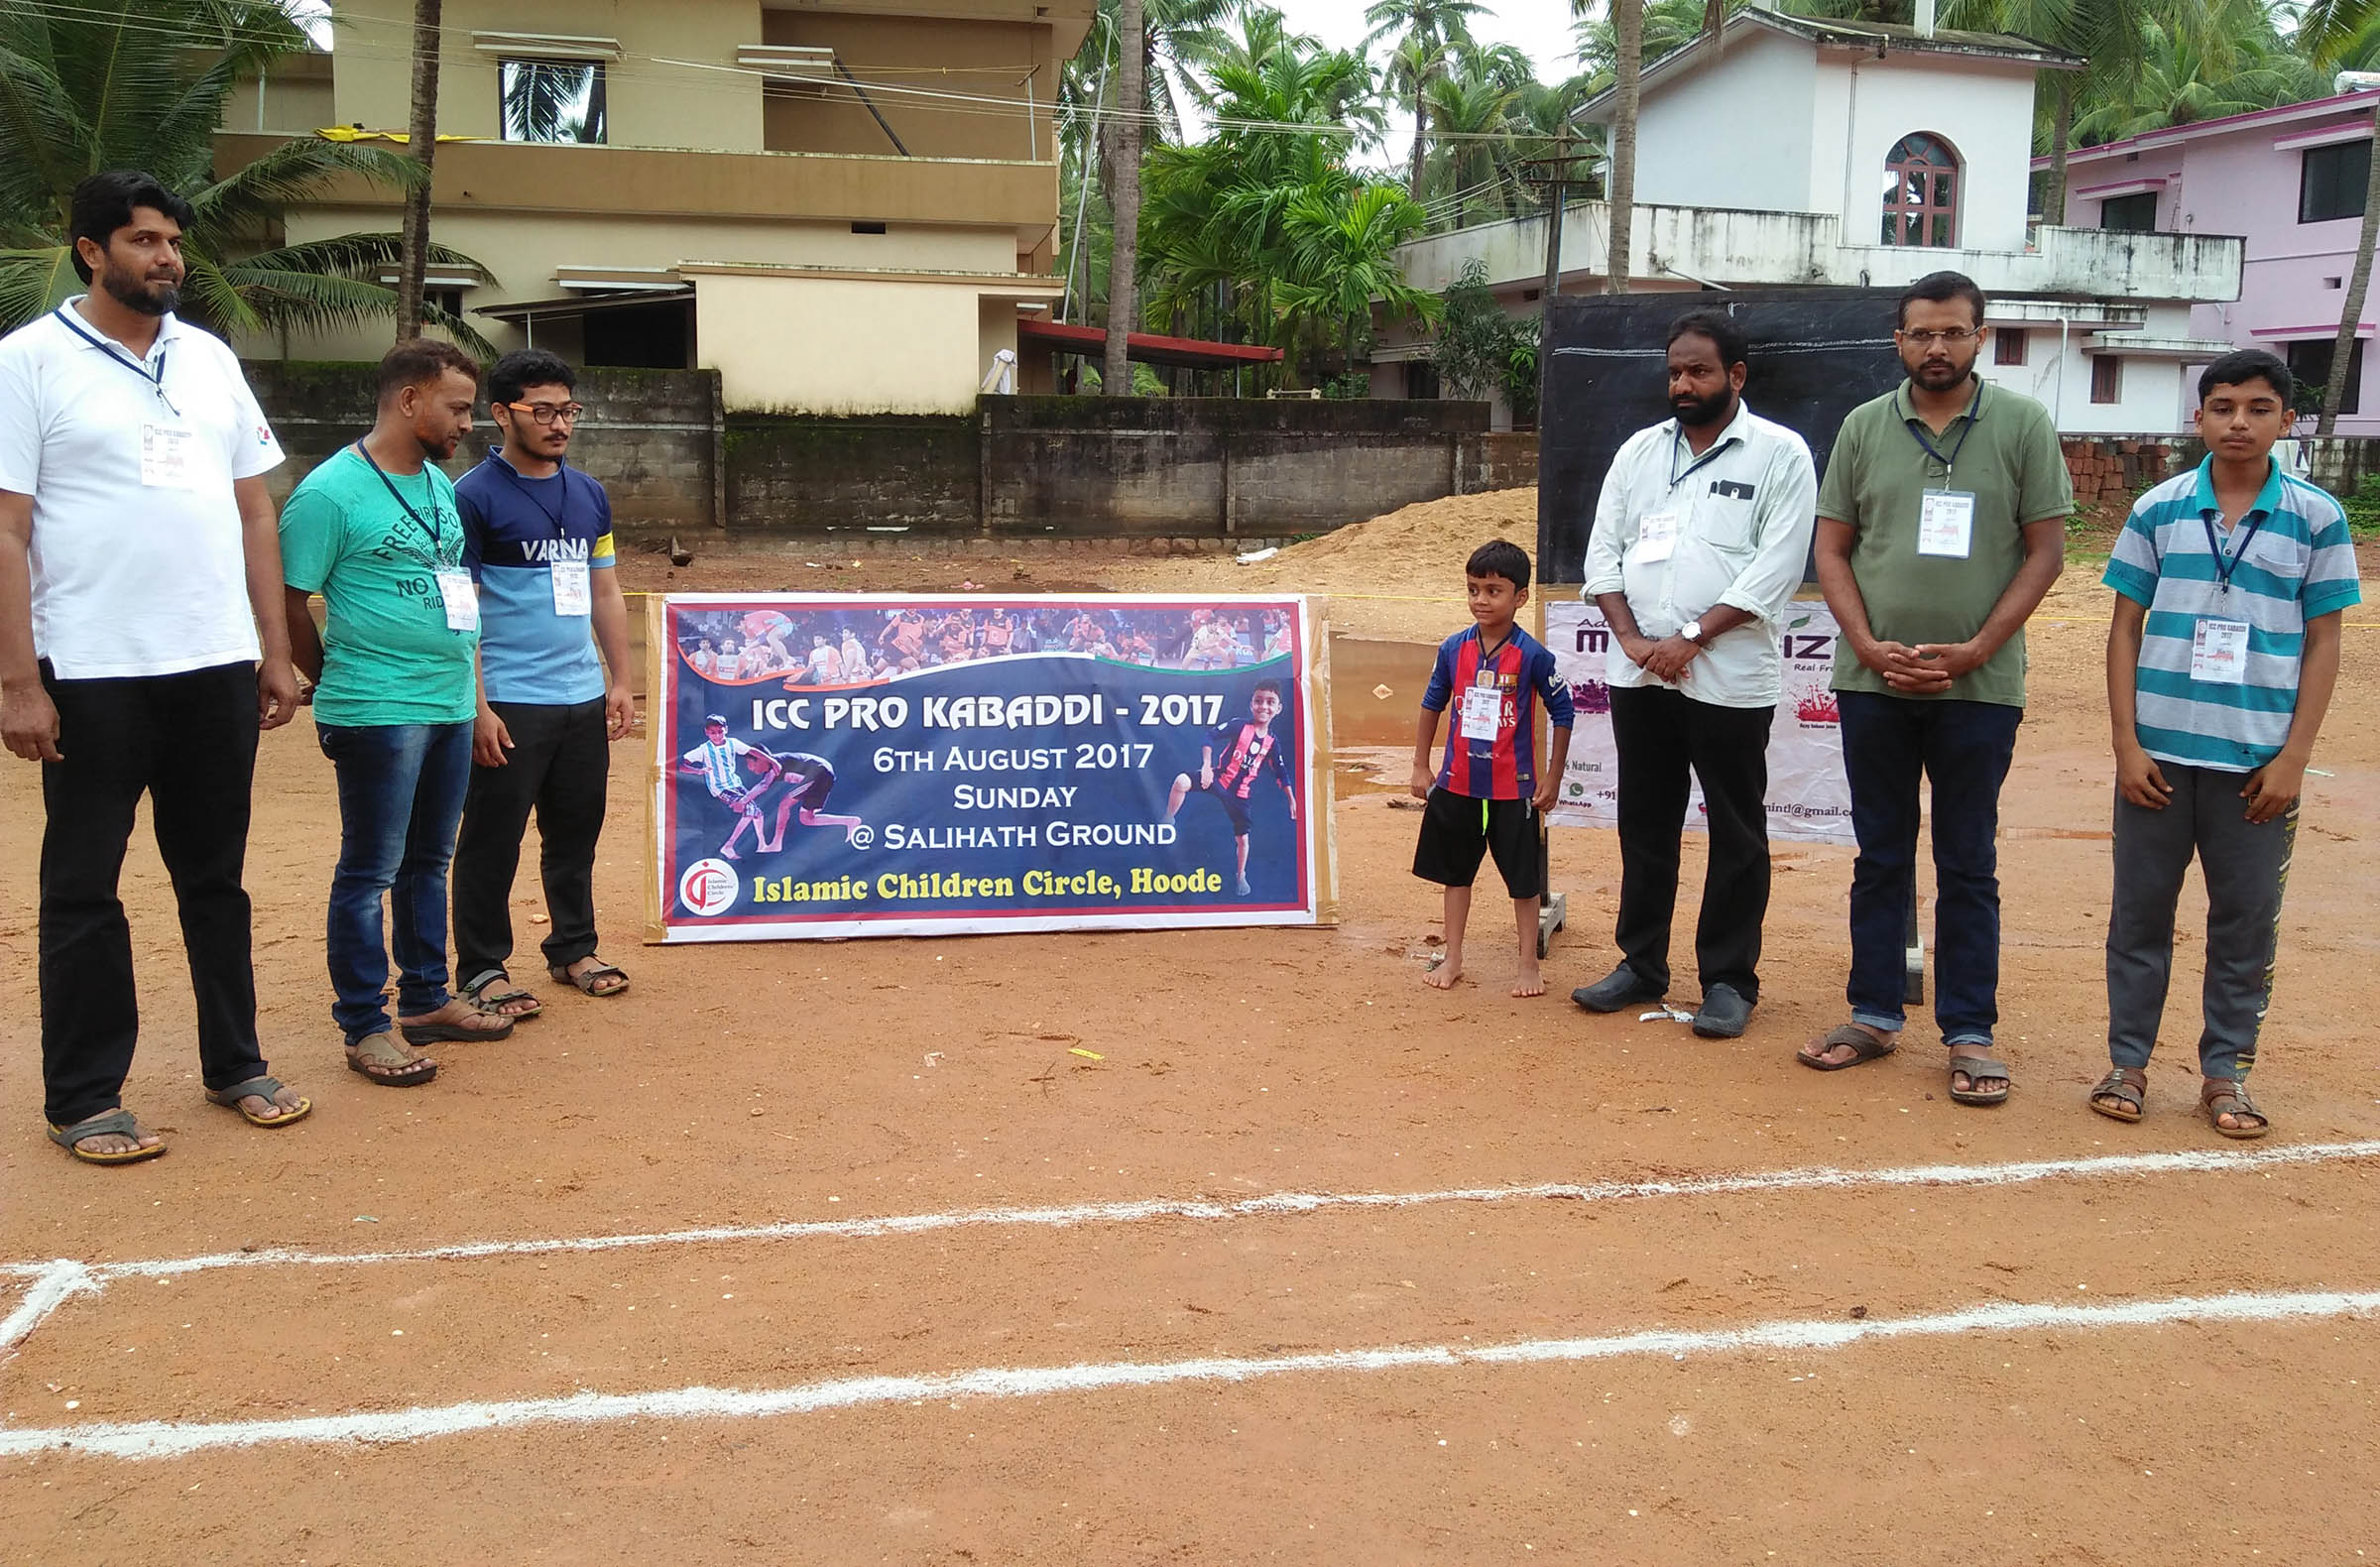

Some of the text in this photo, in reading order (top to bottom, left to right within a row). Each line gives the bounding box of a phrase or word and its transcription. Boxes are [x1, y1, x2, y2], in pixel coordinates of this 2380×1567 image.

[372, 514, 418, 561] FREE
[410, 506, 448, 526] PIRIS
[522, 538, 589, 562] VARNA
[397, 577, 428, 598] NO
[422, 596, 445, 611] RID
[1577, 618, 1610, 628] Ad
[1783, 635, 1838, 660] IZ
[1793, 663, 1816, 672] Real
[752, 698, 810, 731] ICC
[823, 696, 909, 732] PRO
[923, 693, 1104, 732] KABADDI
[1139, 693, 1225, 727] 2017
[873, 743, 1154, 773] 6TH AUGUST 2017
[1572, 760, 1603, 773] Natural
[954, 783, 1078, 810] SUNDAY
[1558, 798, 1593, 808] WhatsApp
[1596, 789, 1617, 801] +91
[850, 820, 1177, 850] @ SALIHATH GROUND
[753, 867, 1222, 904] Islamic Children Circle, Hoode
